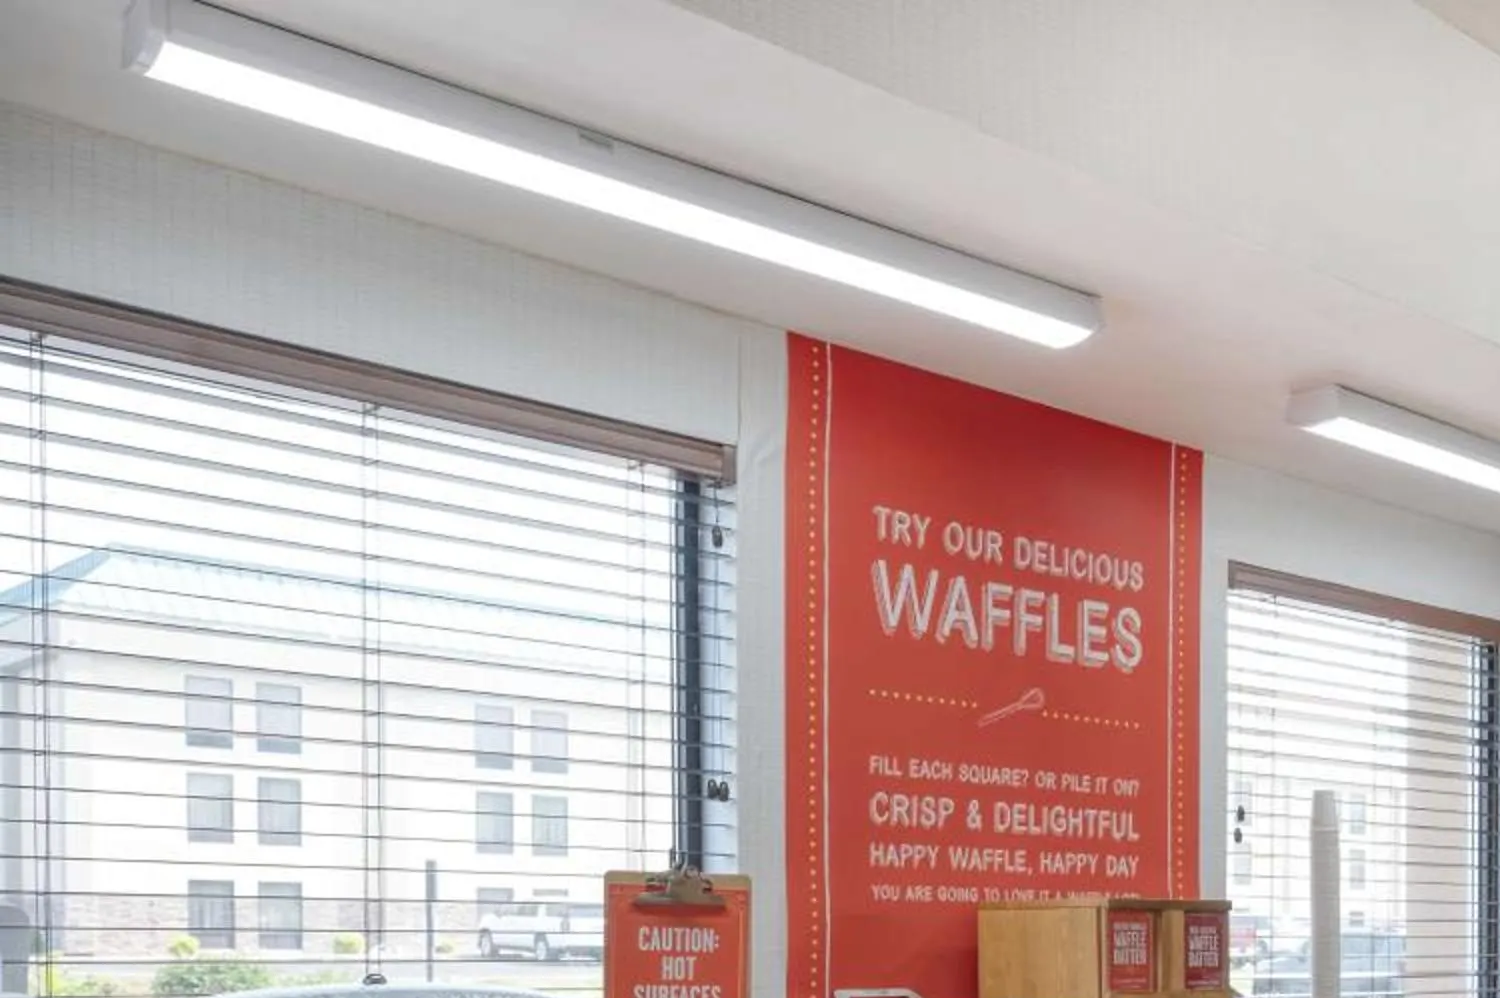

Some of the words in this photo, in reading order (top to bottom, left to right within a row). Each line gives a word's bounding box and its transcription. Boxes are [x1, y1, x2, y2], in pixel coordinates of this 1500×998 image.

[872, 504, 931, 549] TRY
[943, 521, 1004, 565] OUR
[1013, 536, 1144, 592] DELICIOUS
[871, 558, 1144, 673] WAFFLES
[869, 755, 902, 776] FILL
[908, 758, 952, 780] EACH
[958, 763, 1029, 787] SQUARE?
[1035, 771, 1056, 790] OR
[1062, 774, 1091, 794] PILE
[1095, 776, 1108, 793] IT
[1113, 778, 1140, 798] ON?
[869, 791, 955, 829] CRISP
[966, 798, 983, 831] &
[994, 801, 1140, 842] DELIGHTFUL
[869, 842, 940, 869] HAPPY
[949, 846, 1033, 876] WAFFLE,
[1040, 850, 1099, 877] HAPPY
[1105, 854, 1139, 878] DAY
[871, 884, 899, 901] YOU
[906, 885, 933, 902] ARE
[938, 885, 979, 902] GOING
[983, 887, 1000, 903] TO
[638, 925, 720, 951] CAUTION:
[661, 956, 697, 981] HOT
